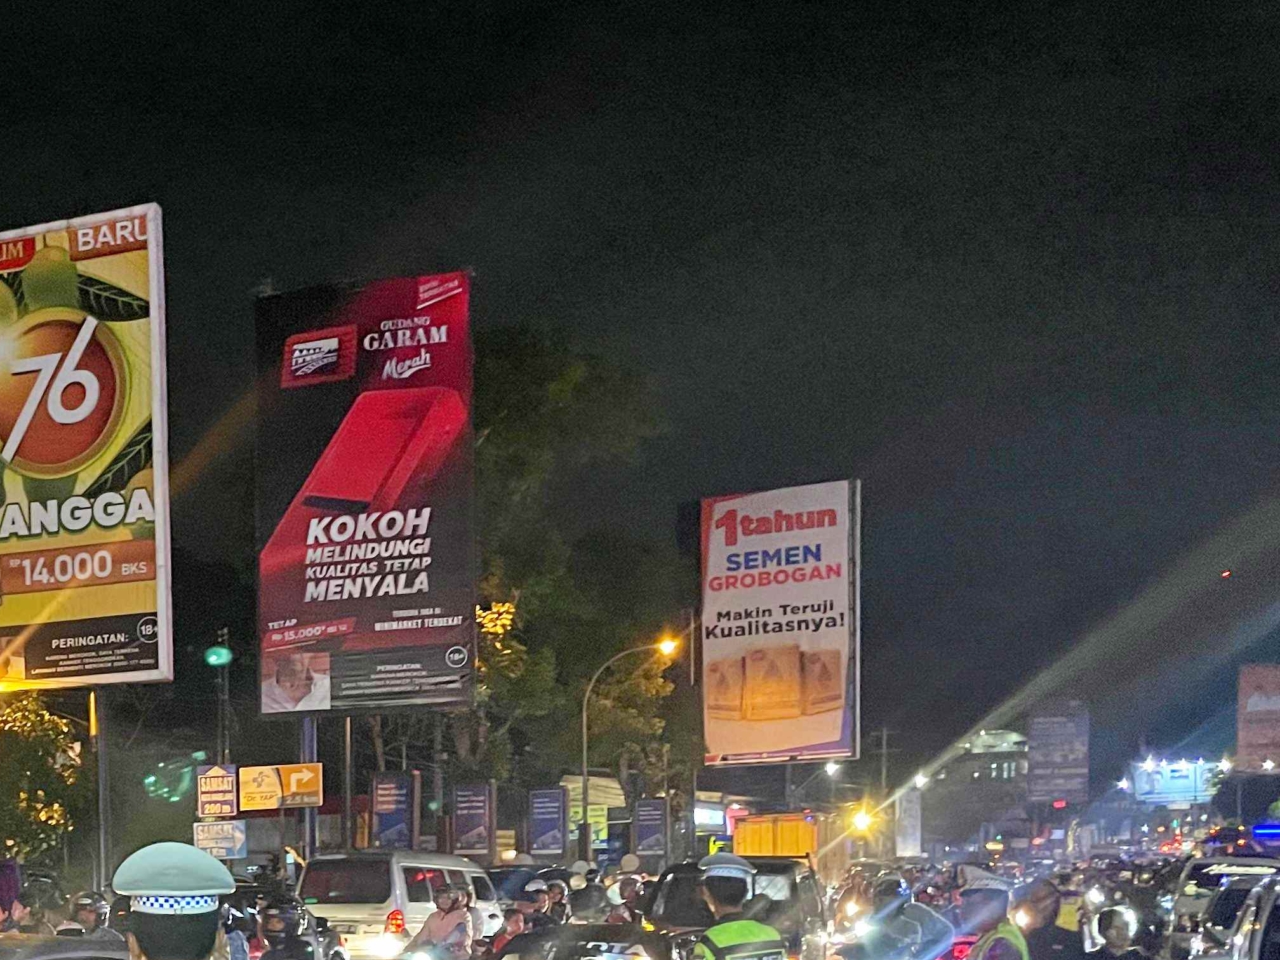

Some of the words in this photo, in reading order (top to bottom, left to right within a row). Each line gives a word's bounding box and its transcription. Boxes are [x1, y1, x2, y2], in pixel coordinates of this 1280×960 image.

[380, 316, 431, 331] GUDANG
[363, 325, 448, 351] GARAM
[382, 348, 431, 380] Merah
[1, 315, 100, 462] 76
[306, 507, 431, 545] KOKOH
[305, 537, 431, 564] MELINDUNGI
[726, 544, 822, 572] SEMEN
[22, 550, 113, 586] 14.000
[121, 562, 148, 577] BKS
[305, 561, 378, 579] KUALITAS
[384, 557, 432, 573] TETAP
[708, 564, 842, 592] GROBOGAN
[304, 571, 429, 603] MENYALA
[717, 604, 773, 623] Makin
[779, 599, 834, 617] Teruji
[705, 612, 845, 640] Kualitasnya!
[51, 632, 129, 649] PERINGATAN:
